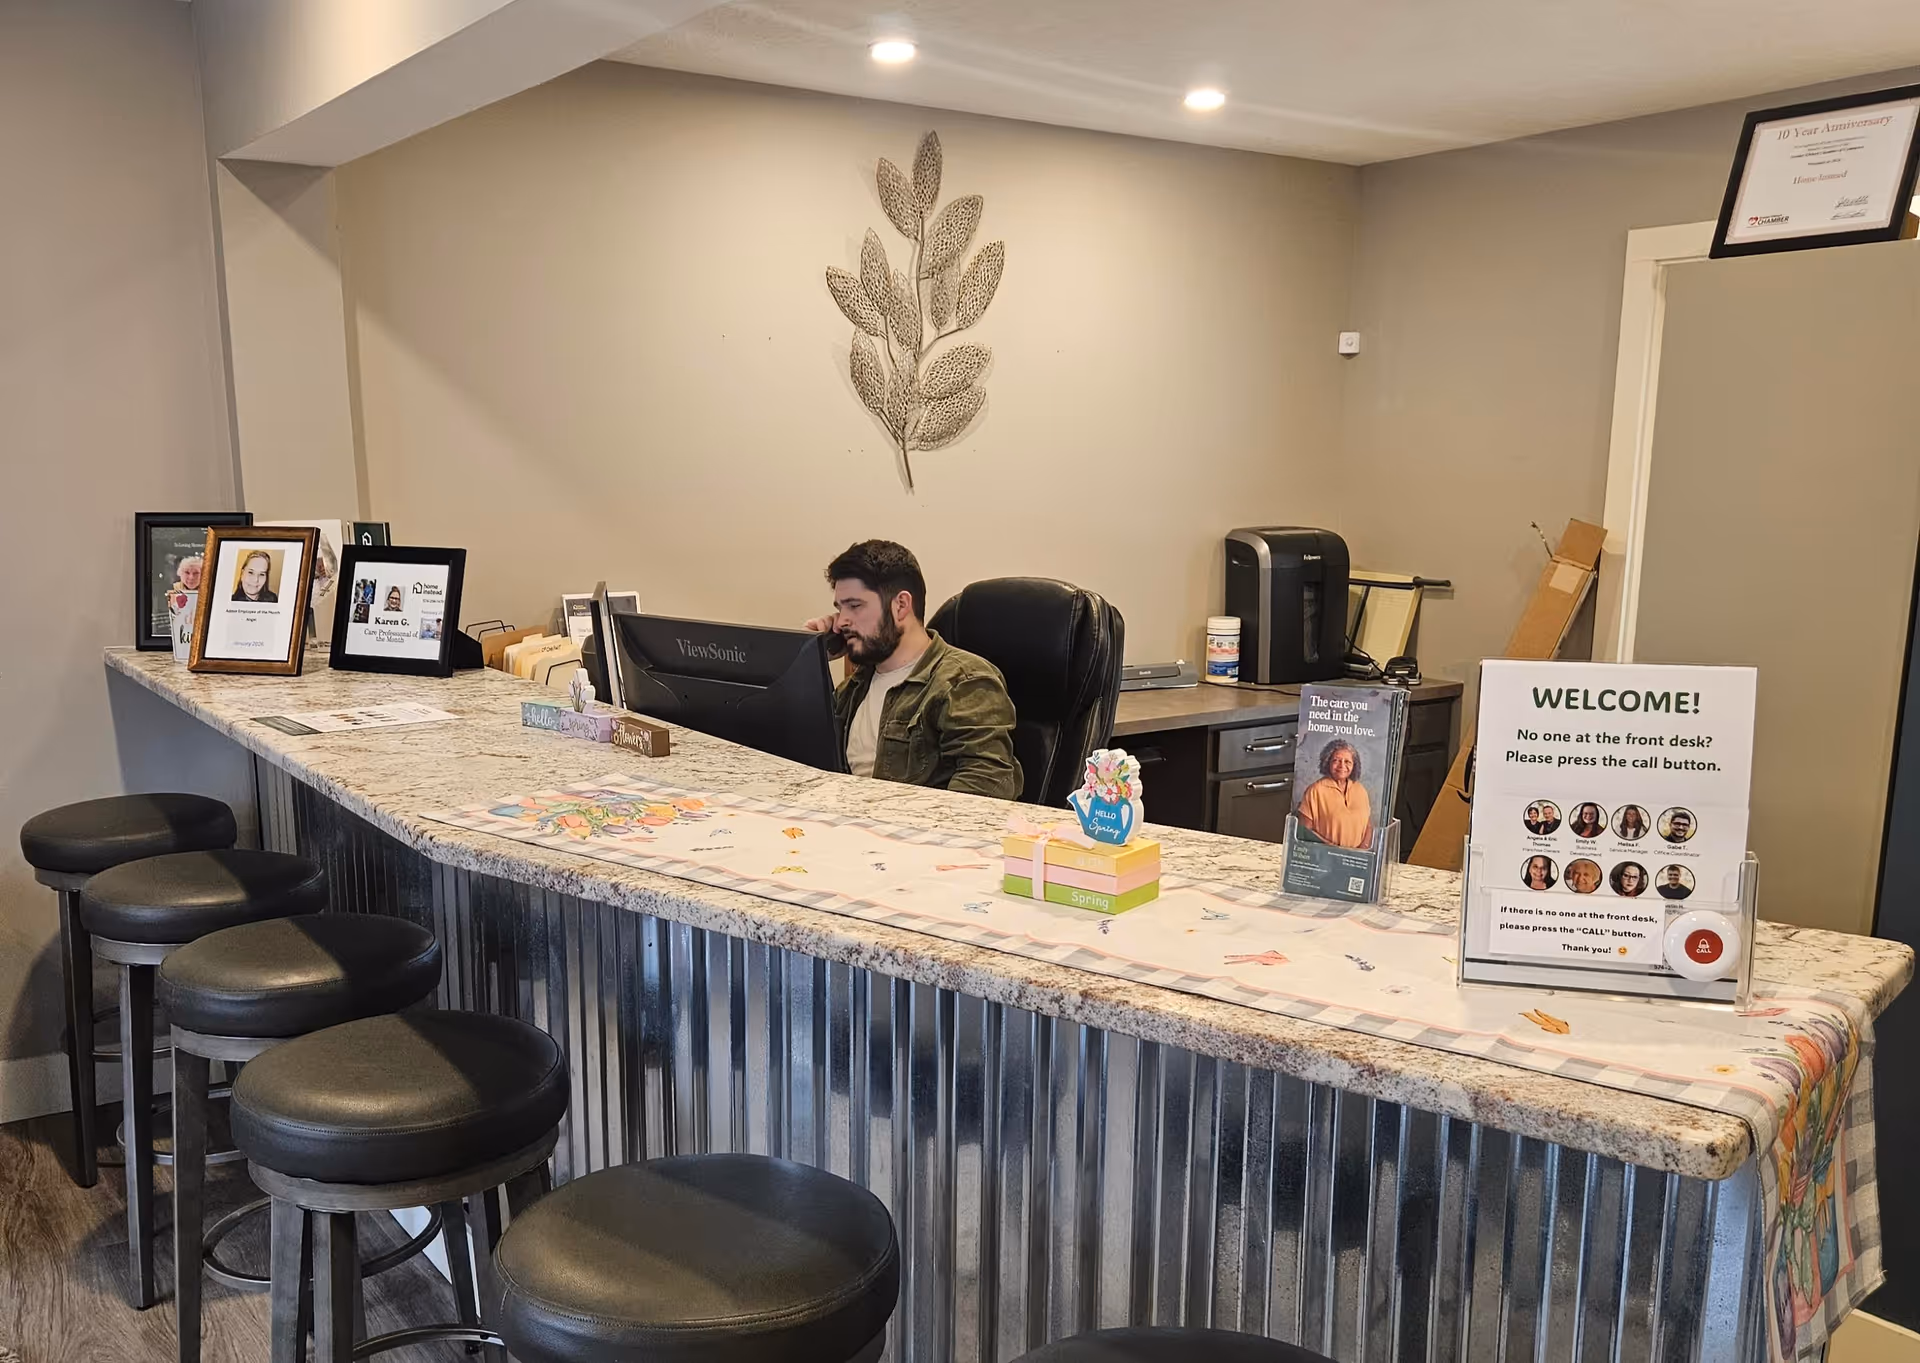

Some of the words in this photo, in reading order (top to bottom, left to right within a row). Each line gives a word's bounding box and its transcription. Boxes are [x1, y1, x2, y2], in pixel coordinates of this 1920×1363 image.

[1777, 129, 1790, 140] 10
[1794, 127, 1819, 138] Year
[1821, 116, 1893, 133] Anniversary
[1757, 216, 1789, 226] CHAMBER
[374, 617, 399, 626] Karen
[401, 618, 410, 626] G.
[364, 628, 378, 636] Care
[378, 628, 412, 638] Professional
[387, 636, 405, 644] Month
[676, 637, 747, 664] ViewSonic
[1310, 695, 1328, 707] The
[1330, 699, 1350, 708] care
[1351, 701, 1368, 712] you
[1532, 686, 1700, 715] WELCOME!
[531, 706, 553, 727] hello
[1309, 709, 1330, 720] need
[1332, 710, 1342, 721] in
[1344, 710, 1359, 722] the
[618, 723, 643, 749] flowers
[1308, 720, 1334, 733] home
[1334, 725, 1352, 736] you
[1354, 724, 1376, 737] love.
[1517, 729, 1538, 741] No
[1543, 732, 1571, 743] one
[1575, 732, 1591, 744] at
[1596, 732, 1620, 744] the
[1626, 732, 1664, 746] front
[1669, 734, 1713, 748] desk?
[1506, 750, 1553, 764] Please
[1558, 754, 1597, 768] press
[1602, 754, 1627, 768] the
[1632, 756, 1658, 769] call
[1663, 757, 1721, 772] button.
[1095, 809, 1117, 820] HELLO
[1088, 817, 1121, 839] Spring
[1072, 891, 1109, 911] Spring
[1509, 906, 1534, 915] there
[1535, 908, 1544, 916] is
[1589, 912, 1604, 920] the
[1606, 912, 1630, 921] front
[1632, 915, 1658, 924] desk,
[1500, 922, 1530, 931] please
[1560, 926, 1574, 934] the
[1612, 930, 1646, 938] button.
[1562, 944, 1590, 953] Thank
[1592, 946, 1612, 954] you!
